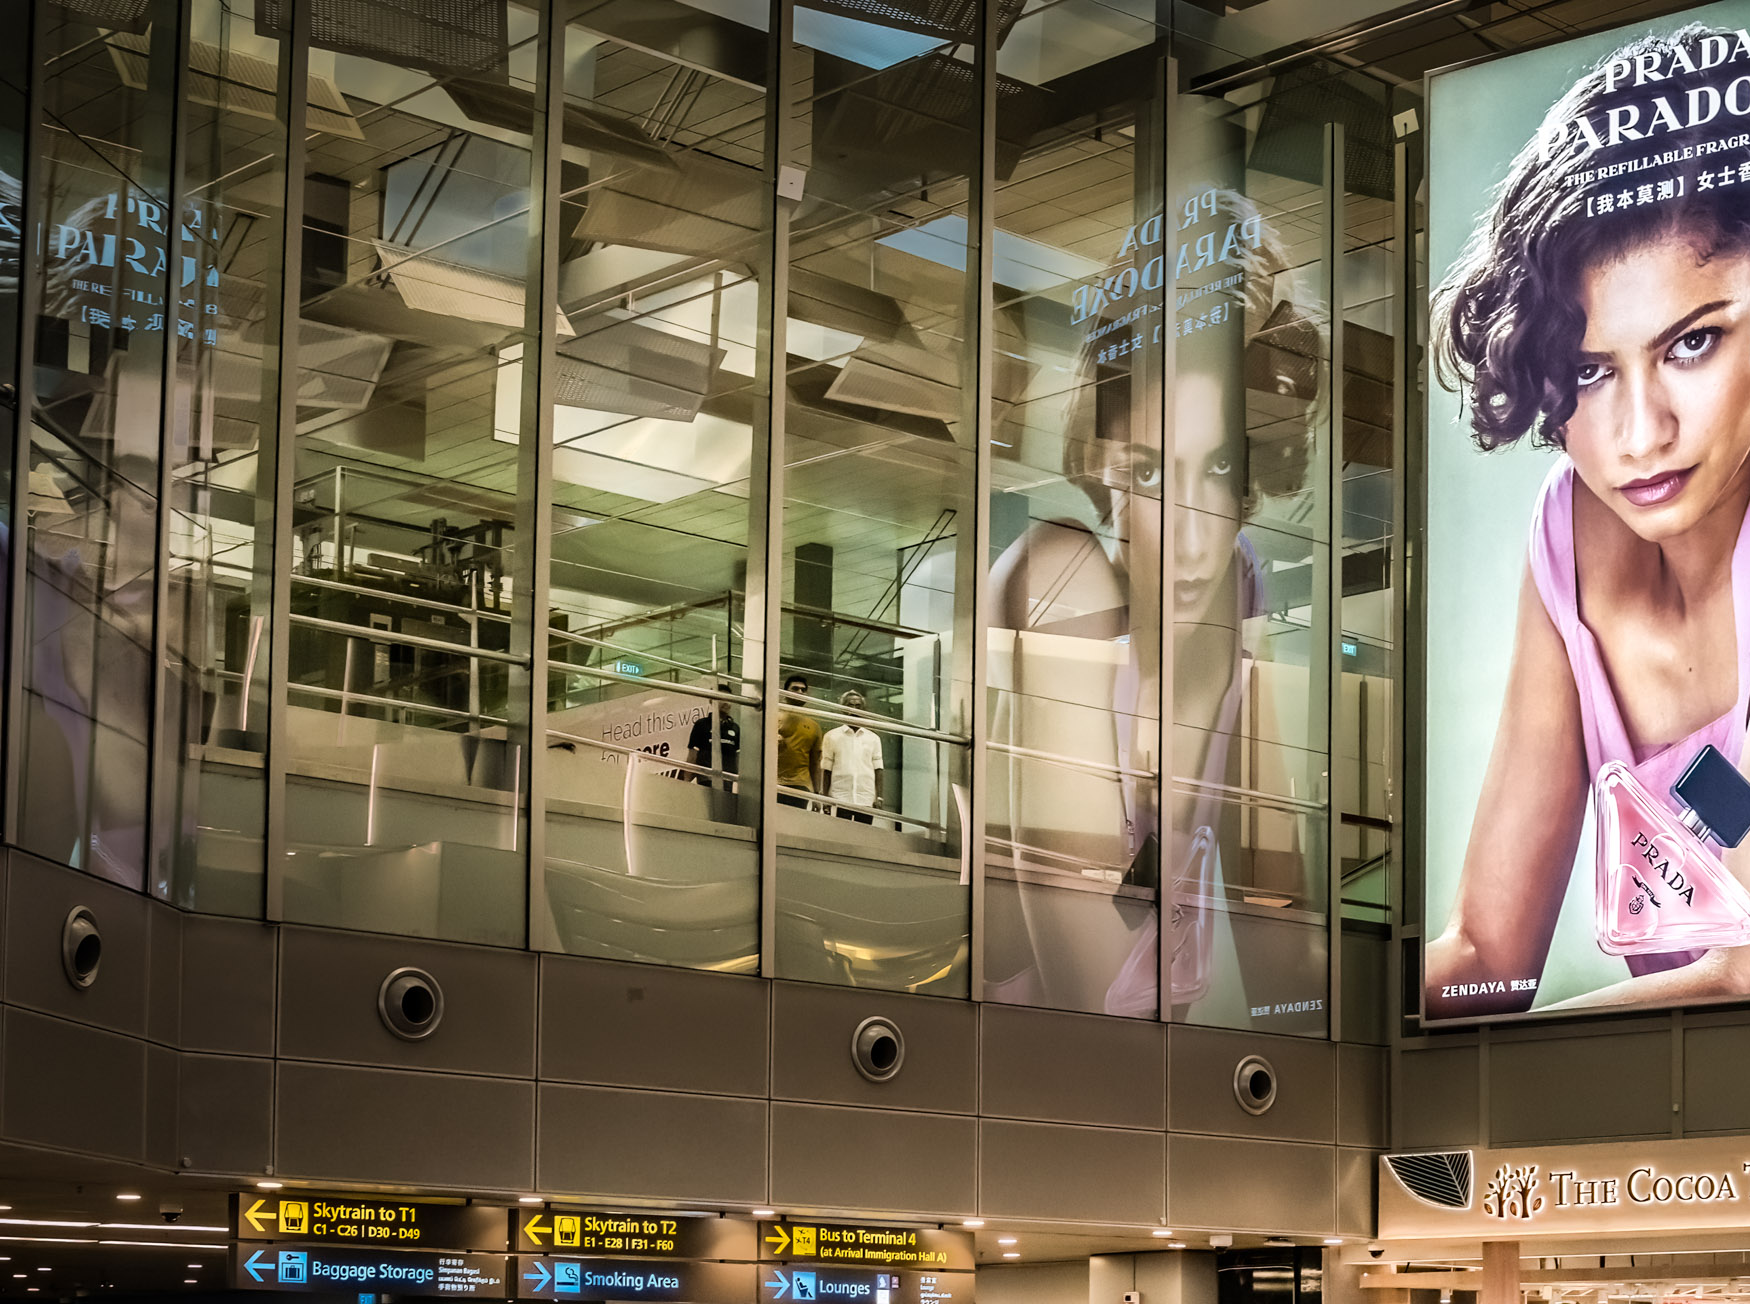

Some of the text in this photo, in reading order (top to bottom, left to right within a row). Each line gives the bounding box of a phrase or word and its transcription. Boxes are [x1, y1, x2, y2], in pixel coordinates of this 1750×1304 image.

[1565, 167, 1595, 188] THE
[1597, 145, 1694, 182] REFILLABLE
[602, 716, 641, 742] Head
[647, 712, 675, 734] this
[1631, 832, 1696, 907] PRADA
[1442, 981, 1505, 998] ZENDAYA
[313, 1202, 416, 1222] Skytrain to T1
[313, 1224, 328, 1236] C1
[337, 1225, 358, 1237] C26
[369, 1226, 389, 1238] D30
[399, 1228, 420, 1239] D49
[584, 1217, 677, 1235] Skytrain to T2
[584, 1236, 597, 1247] E1
[604, 1237, 623, 1249] E28
[631, 1239, 648, 1249] F31
[656, 1240, 674, 1250] F60
[820, 1228, 916, 1245] Bus to Terminal 4
[820, 1247, 947, 1263] (at Arrival Immigration Hall A)
[313, 1262, 375, 1281] Baggage
[379, 1263, 434, 1283] Storage
[585, 1272, 679, 1290] Smoking Area
[819, 1280, 870, 1297] Lounges
